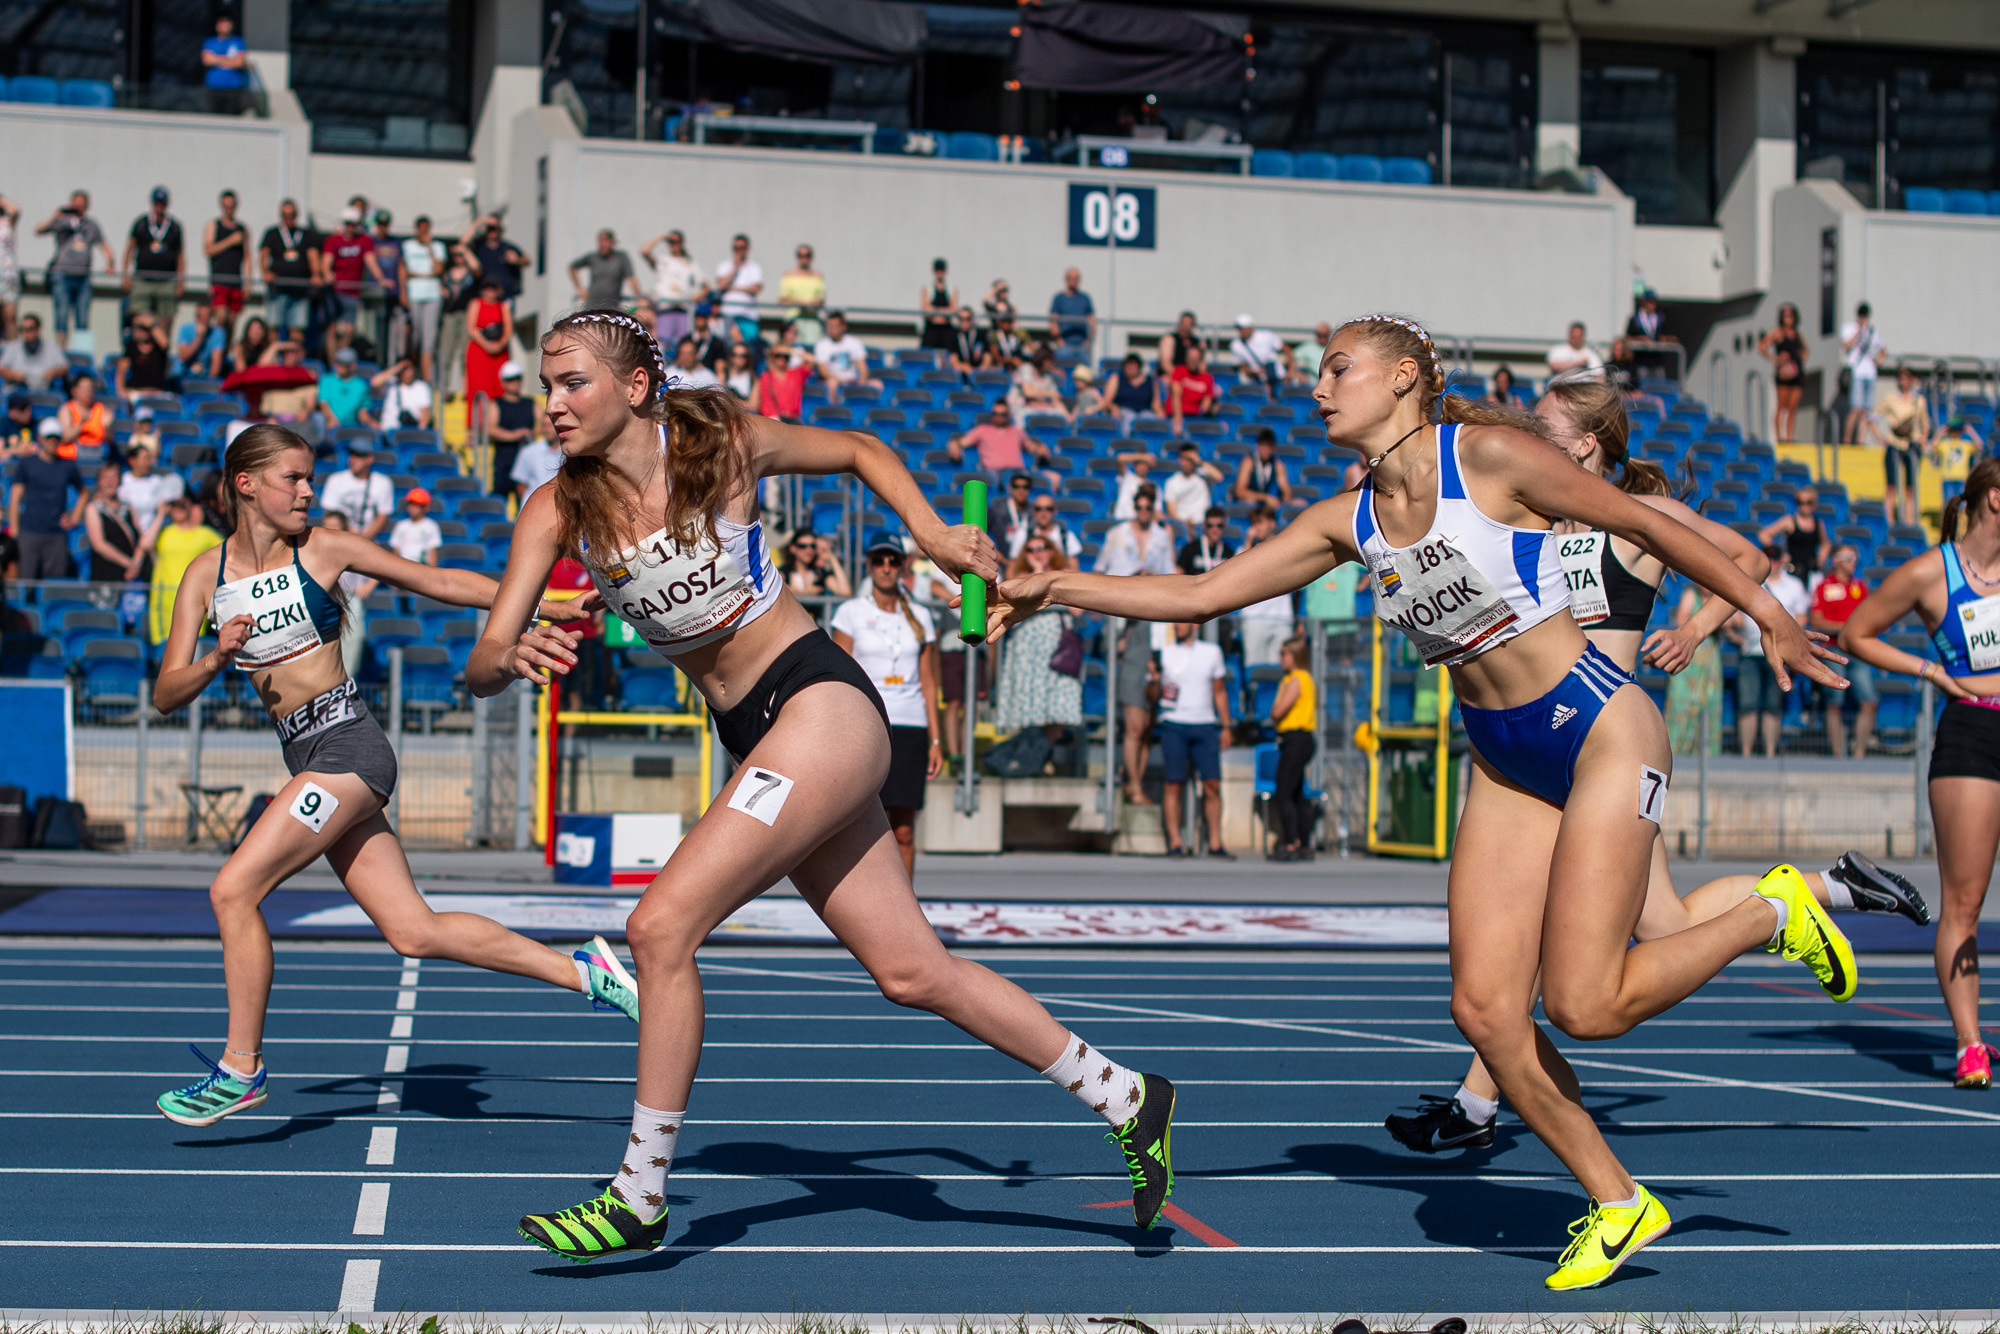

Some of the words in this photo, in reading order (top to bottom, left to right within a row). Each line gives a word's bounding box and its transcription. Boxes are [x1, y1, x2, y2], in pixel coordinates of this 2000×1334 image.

[1083, 190, 1140, 241] 08
[1415, 539, 1454, 575] 181
[1560, 537, 1596, 557] 622
[251, 573, 290, 599] 618
[622, 560, 727, 621] GAJOSZ
[1389, 575, 1483, 631] WÓJCIK
[668, 618, 712, 638] Mistrzostwa
[711, 598, 736, 620] Polski
[734, 587, 750, 602] U18
[1474, 612, 1497, 630] Polski
[1495, 604, 1511, 617] U18
[1572, 604, 1592, 615] Polski
[1593, 603, 1607, 612] U18
[284, 638, 304, 651] Polski
[303, 631, 318, 643] U18
[1551, 707, 1578, 730] adidas
[744, 771, 782, 811] 7
[1645, 770, 1663, 815] 7
